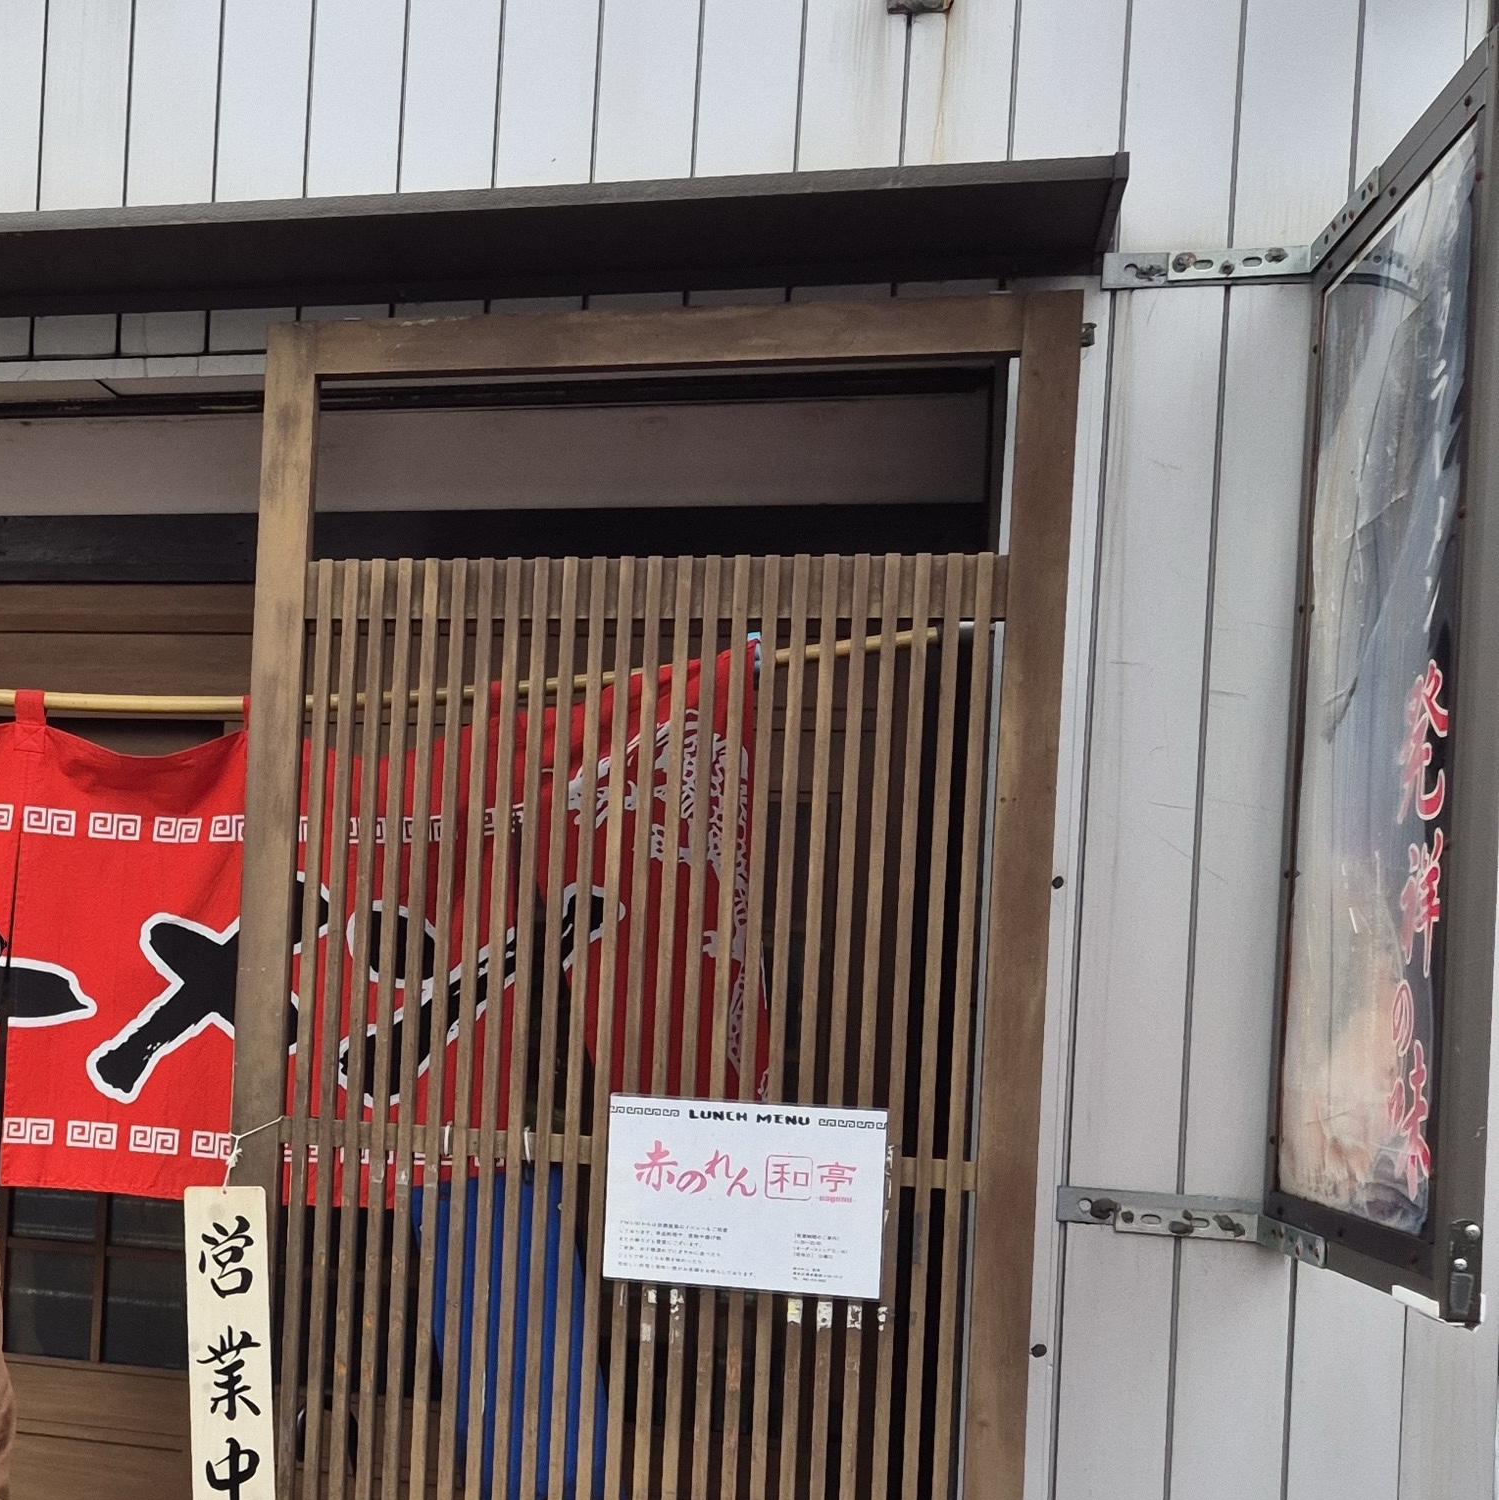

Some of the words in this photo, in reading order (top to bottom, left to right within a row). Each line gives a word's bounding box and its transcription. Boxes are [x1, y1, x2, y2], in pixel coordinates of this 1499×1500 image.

[688, 1108, 748, 1123] LUNCH
[756, 1113, 811, 1127] MENU
[633, 1139, 757, 1198] 赤のれん
[768, 1161, 858, 1194] 和亭
